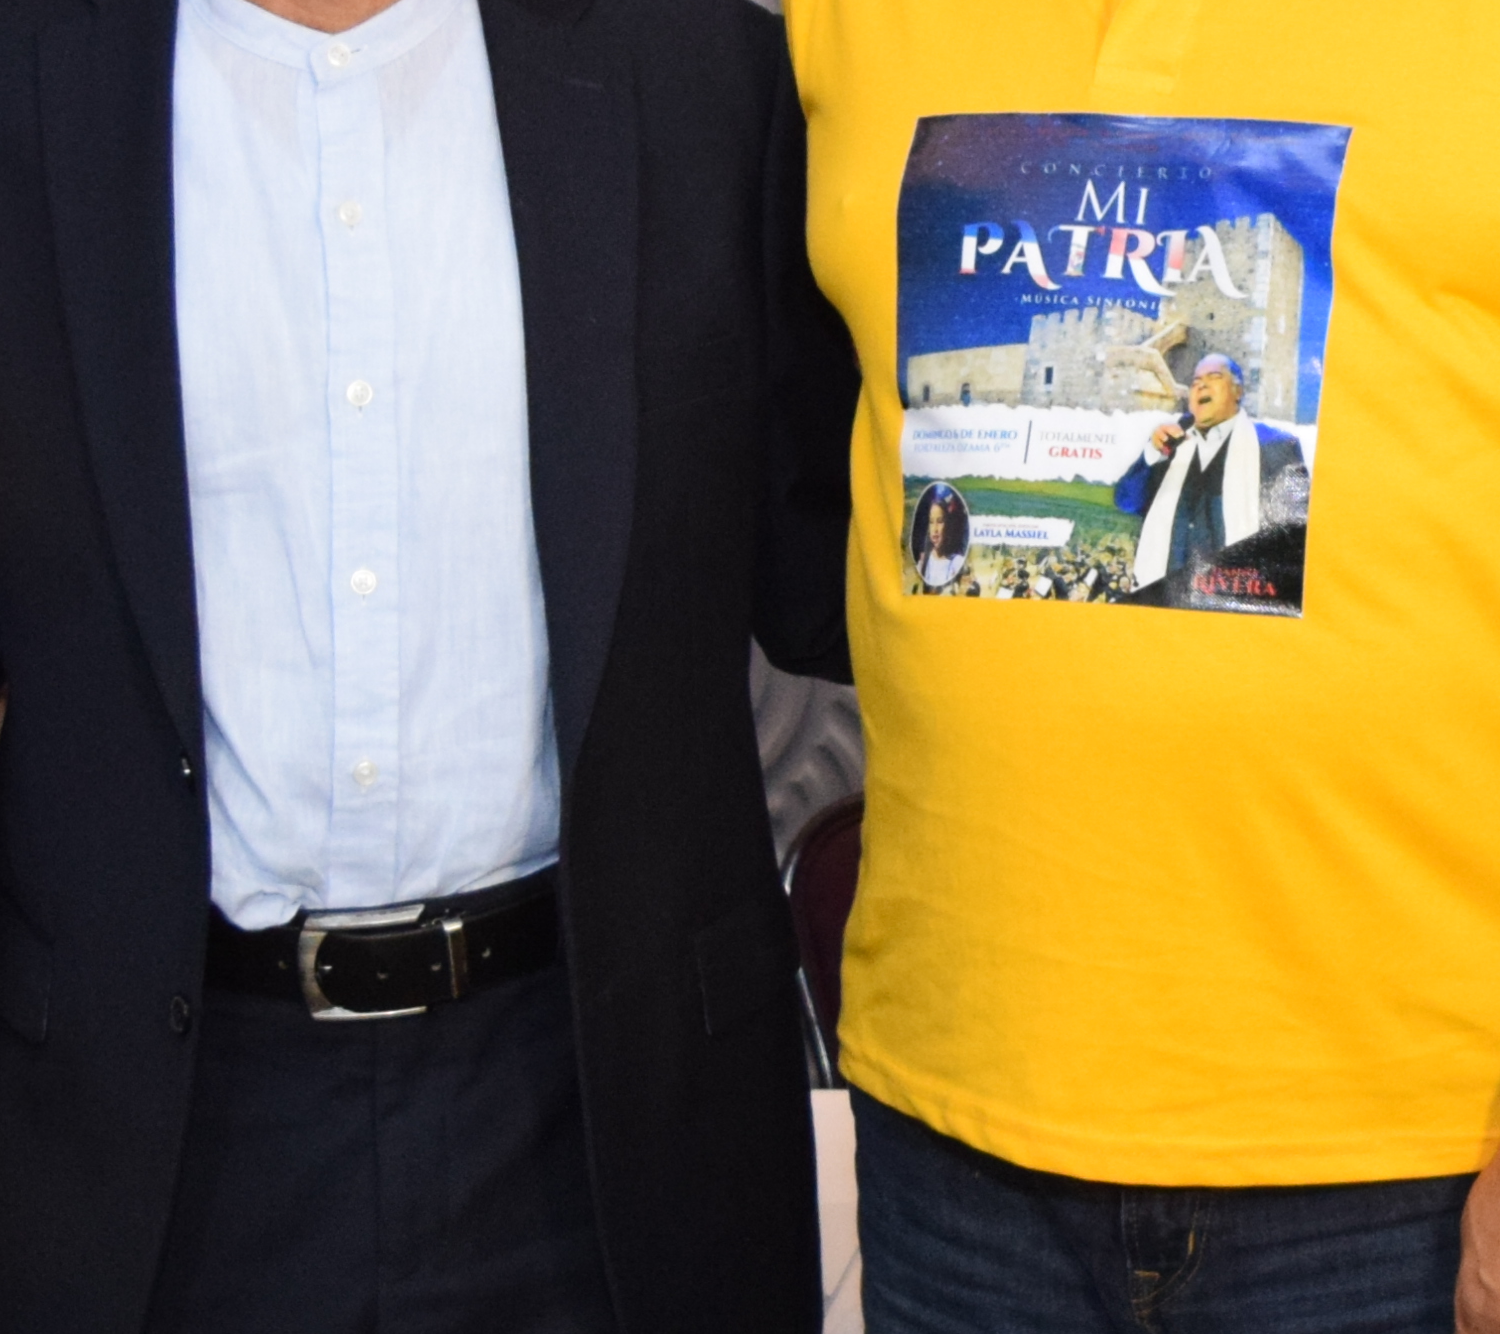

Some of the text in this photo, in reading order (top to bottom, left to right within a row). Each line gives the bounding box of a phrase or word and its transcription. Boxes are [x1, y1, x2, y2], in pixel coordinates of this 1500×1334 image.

[1075, 179, 1149, 225] MI
[959, 220, 1249, 300] PATRIA
[977, 429, 1018, 440] ENERO
[1048, 446, 1103, 459] GRATIS
